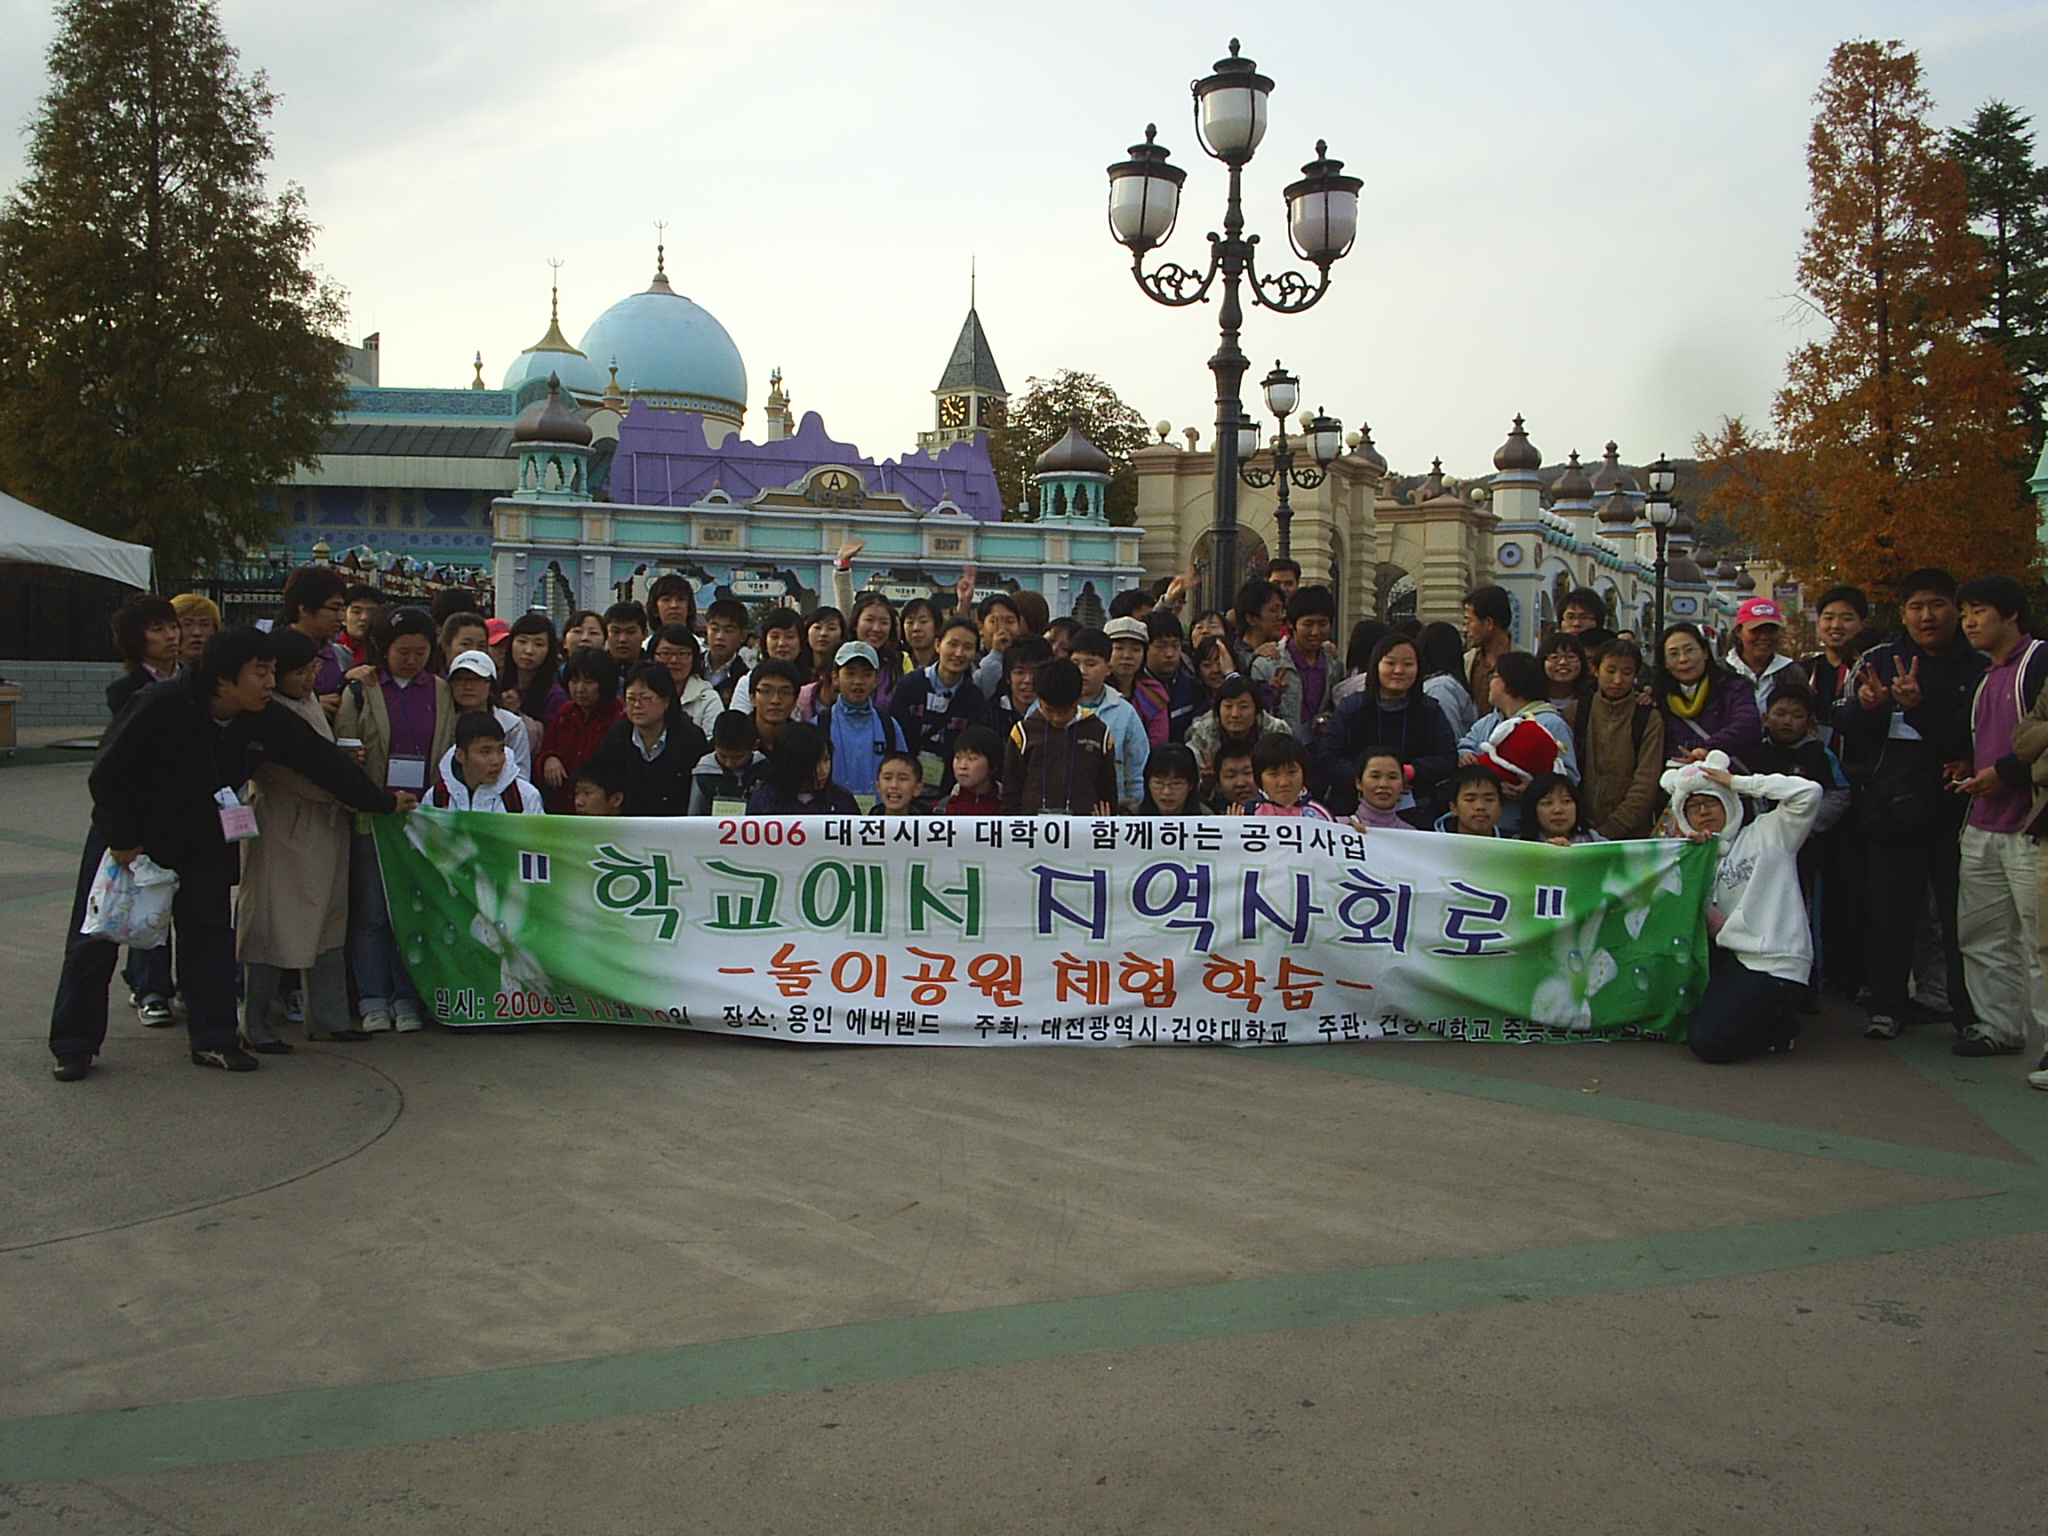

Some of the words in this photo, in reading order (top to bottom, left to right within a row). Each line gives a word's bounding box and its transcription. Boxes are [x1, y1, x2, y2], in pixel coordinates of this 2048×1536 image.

[828, 472, 841, 490] A
[703, 527, 733, 541] EXIT
[934, 537, 963, 551] EXIT
[717, 819, 807, 846] 2006
[824, 819, 957, 848] 대전시와
[975, 819, 1070, 849] 대학이
[1091, 820, 1223, 850] 함께하는
[1240, 823, 1367, 862] 공익사업
[1052, 951, 1178, 1009] 체험
[434, 987, 485, 1020] 일시:
[493, 990, 579, 1018] 2006년
[722, 1004, 777, 1032] 장소:
[786, 1004, 833, 1034] 용인
[846, 1008, 940, 1036] 에버랜드
[973, 1014, 1028, 1040] 주최:
[1318, 1012, 1370, 1042] 주관:
